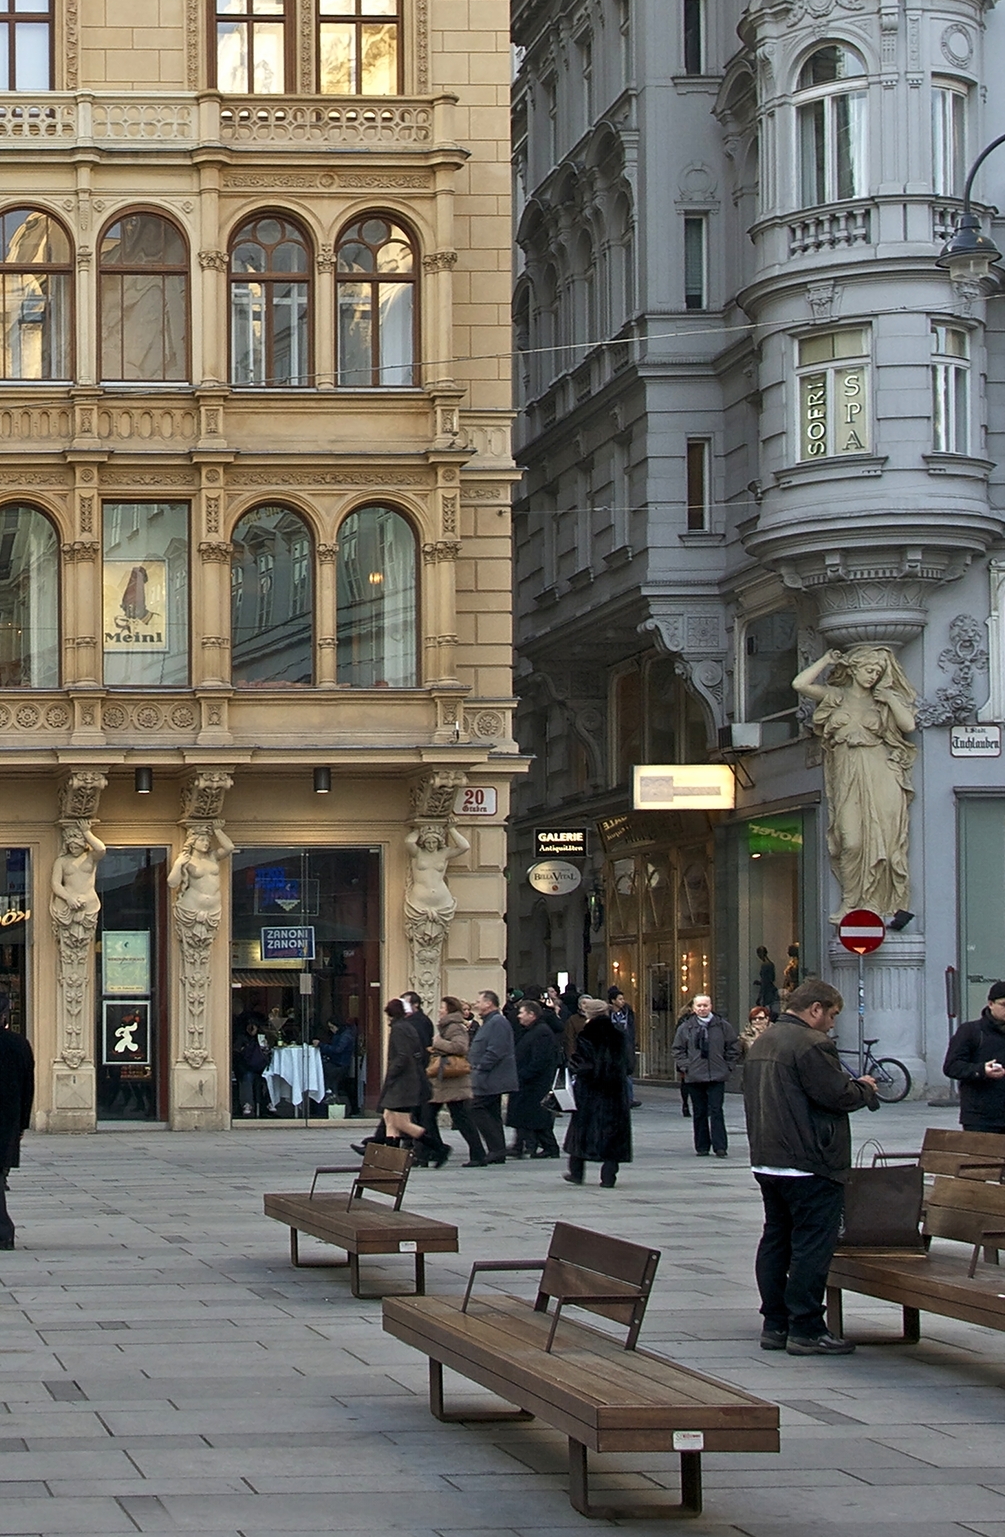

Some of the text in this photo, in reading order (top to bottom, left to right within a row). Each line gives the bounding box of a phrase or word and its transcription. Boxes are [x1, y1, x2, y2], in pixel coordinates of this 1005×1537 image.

[842, 375, 865, 450] SPA
[105, 631, 163, 643] Meinl
[463, 789, 484, 804] 20
[538, 833, 583, 842] GALERIE
[267, 930, 308, 939] ZANONI
[267, 939, 308, 949] ZANONI
